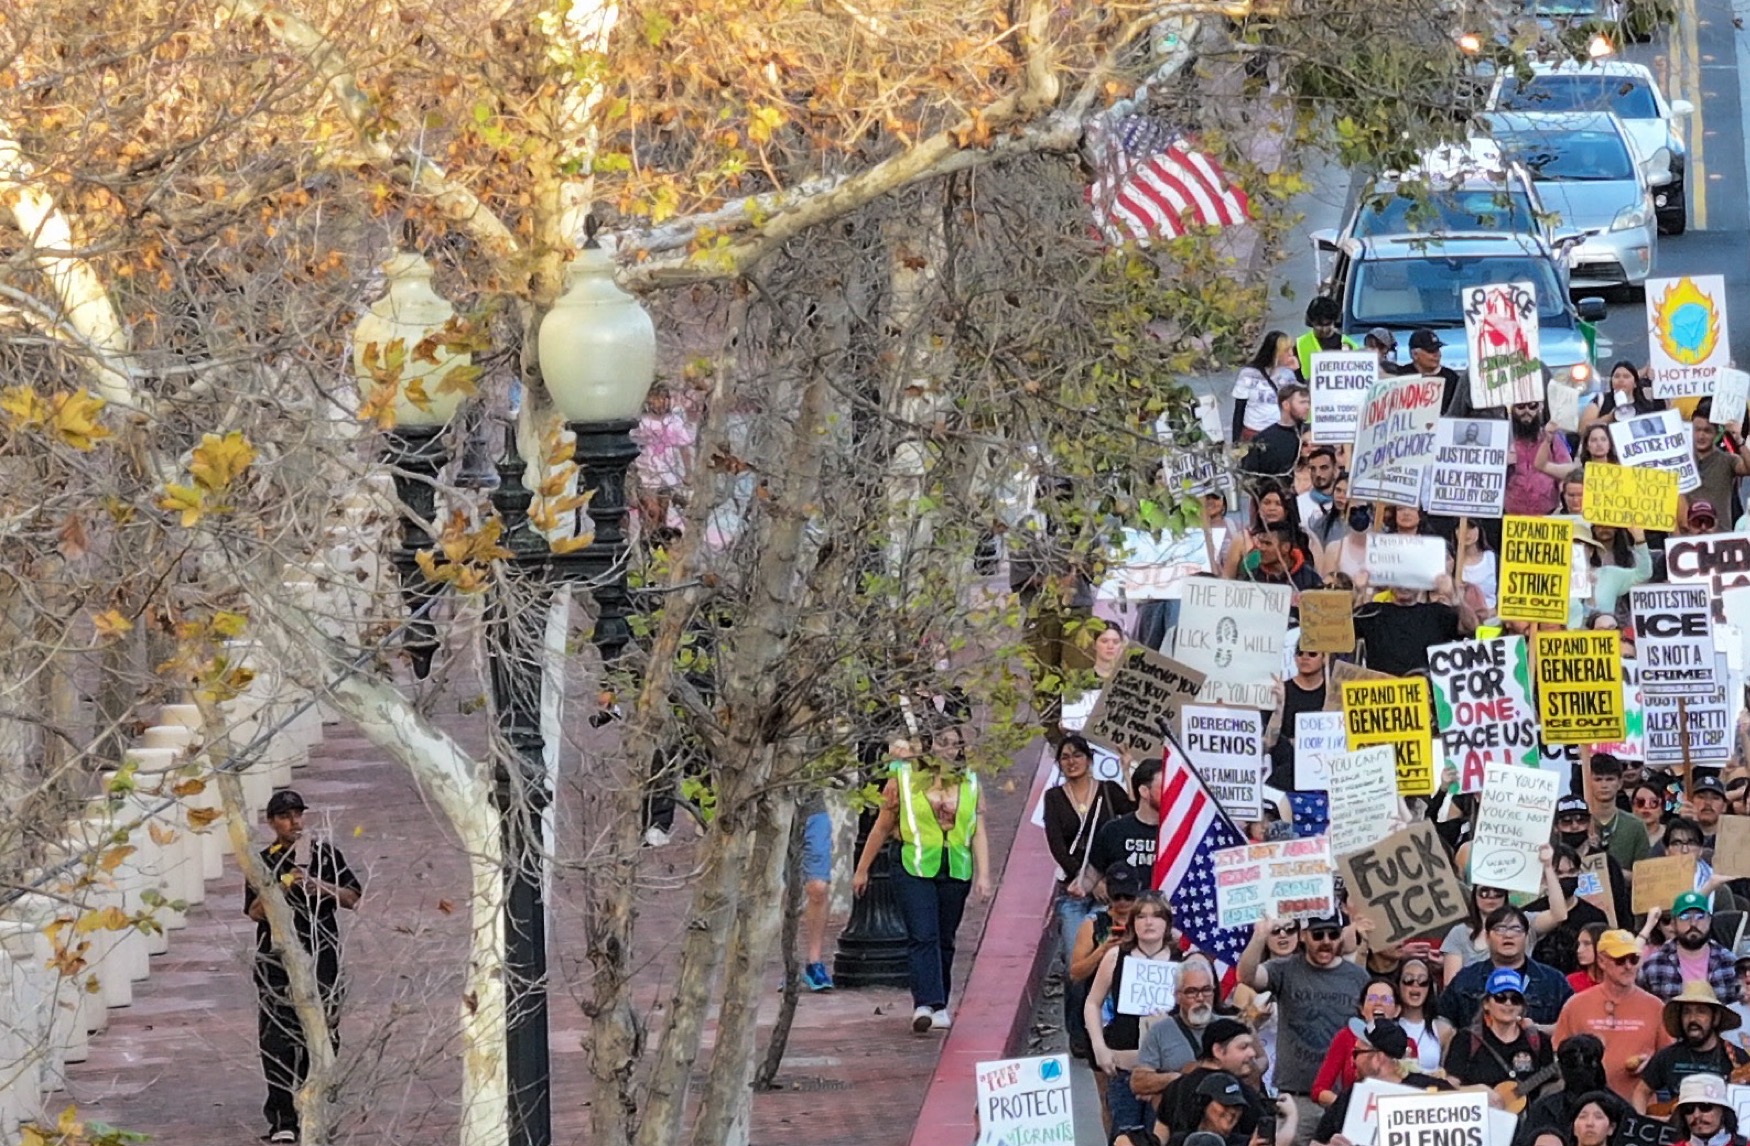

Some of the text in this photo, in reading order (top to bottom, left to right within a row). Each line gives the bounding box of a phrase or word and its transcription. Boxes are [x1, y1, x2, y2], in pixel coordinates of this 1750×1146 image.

[1465, 283, 1536, 325] NO ICE
[1315, 373, 1374, 392] PLENOS
[1658, 369, 1689, 380] HOT
[1659, 382, 1697, 396] MELT
[1436, 447, 1504, 465] JUSTICE FOR
[1189, 584, 1217, 608] THE
[1261, 587, 1287, 614] YOU
[1633, 589, 1707, 609] PROTESTING
[1635, 614, 1708, 638] ICE
[1179, 628, 1277, 654] LICK WILL
[1540, 640, 1614, 656] EXPAND THE
[1429, 641, 1506, 676] COME
[1541, 656, 1616, 682] GENERAL
[1450, 668, 1505, 699] FOR
[1641, 669, 1712, 681] CRIME!
[1346, 683, 1422, 706] EXPAND THE
[1548, 691, 1613, 715] STRIKE!
[1349, 705, 1425, 733] GENERAL
[1188, 734, 1257, 755] PLENOS
[1348, 830, 1448, 901] FUCK
[1367, 876, 1459, 945] ICE
[988, 1087, 1070, 1124] PROTECT
[1387, 1105, 1482, 1130] ¡DERECHOS
